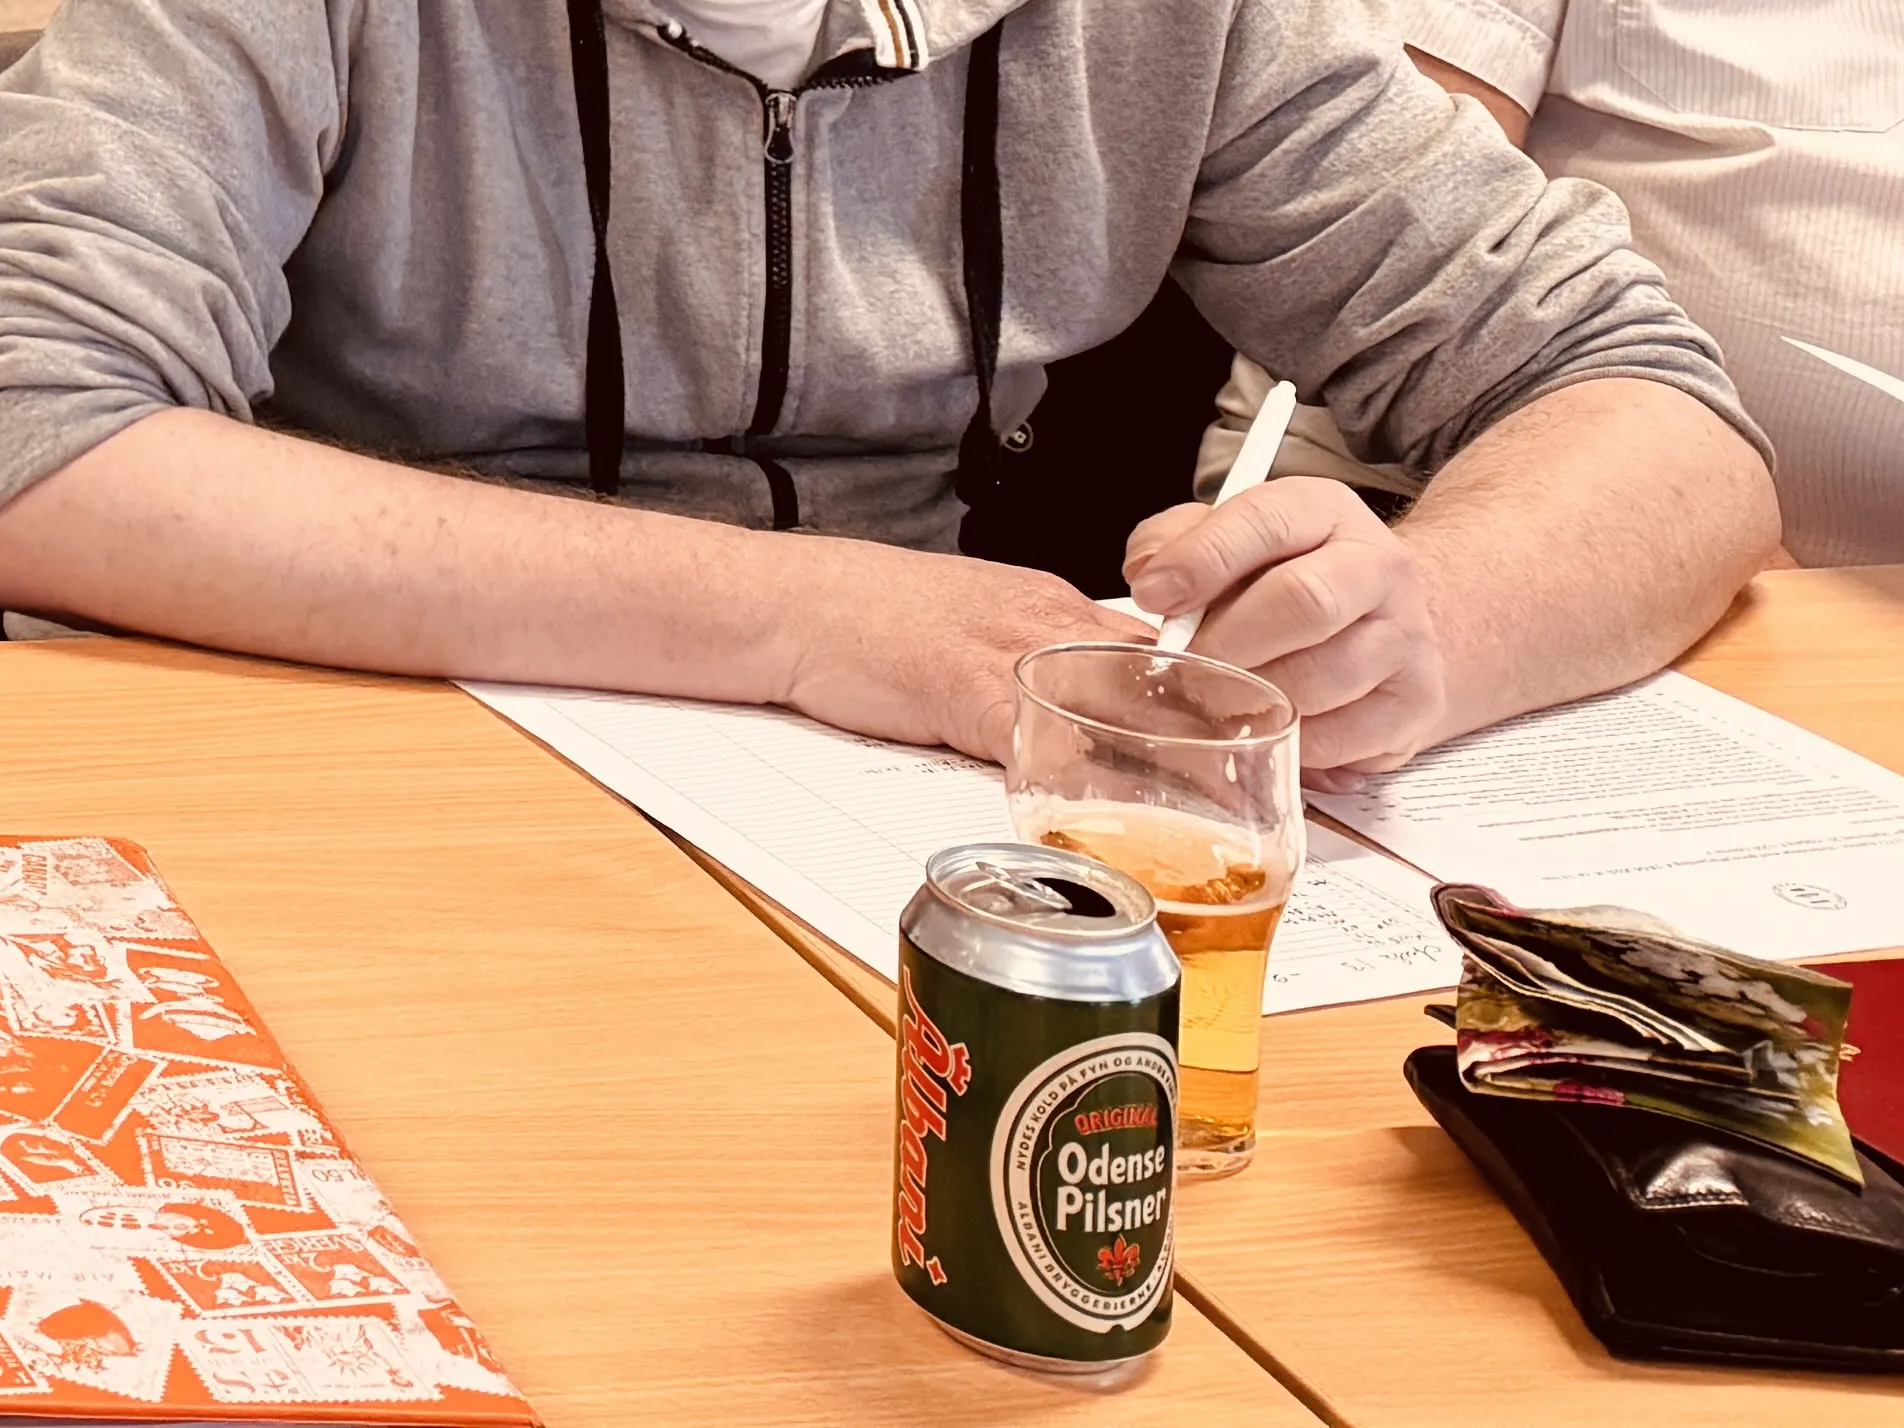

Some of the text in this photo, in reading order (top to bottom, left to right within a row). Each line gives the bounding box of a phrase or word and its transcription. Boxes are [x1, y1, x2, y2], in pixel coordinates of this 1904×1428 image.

[1016, 1125, 1036, 1170] NYDES
[1031, 1092, 1059, 1124] KOLD
[1059, 1074, 1079, 1092] PÅ
[1080, 1061, 1109, 1080] FYN
[1074, 1104, 1159, 1136] ORIGINAL
[1057, 1141, 1166, 1186] Odense
[1056, 1185, 1168, 1234] Pilsner
[264, 1233, 363, 1252] SVERIGE
